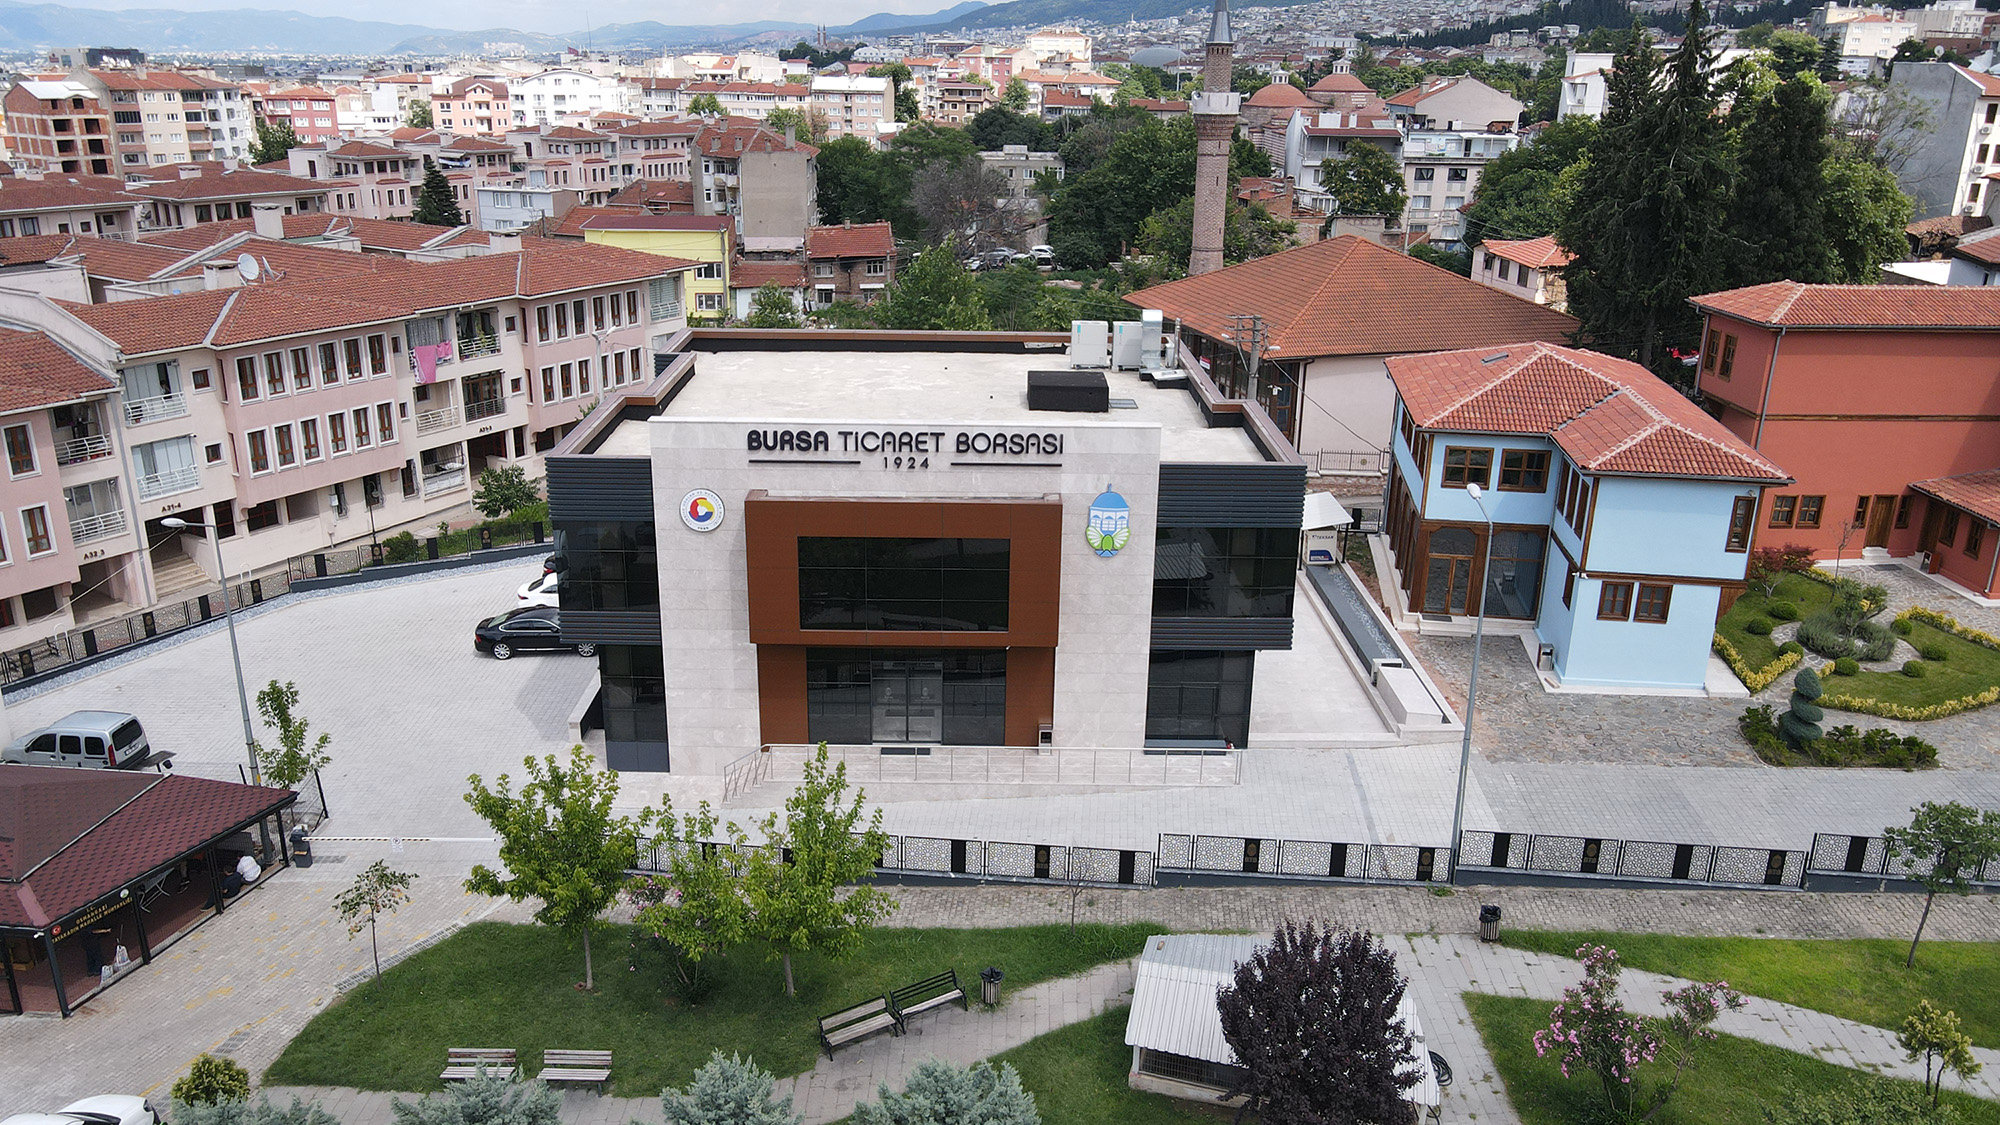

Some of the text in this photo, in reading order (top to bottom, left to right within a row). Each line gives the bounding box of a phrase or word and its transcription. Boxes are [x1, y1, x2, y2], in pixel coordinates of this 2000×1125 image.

[747, 429, 829, 452] BURSA
[955, 432, 1064, 455] BORSASI
[883, 457, 929, 470] 1924
[161, 502, 182, 513] A31-4
